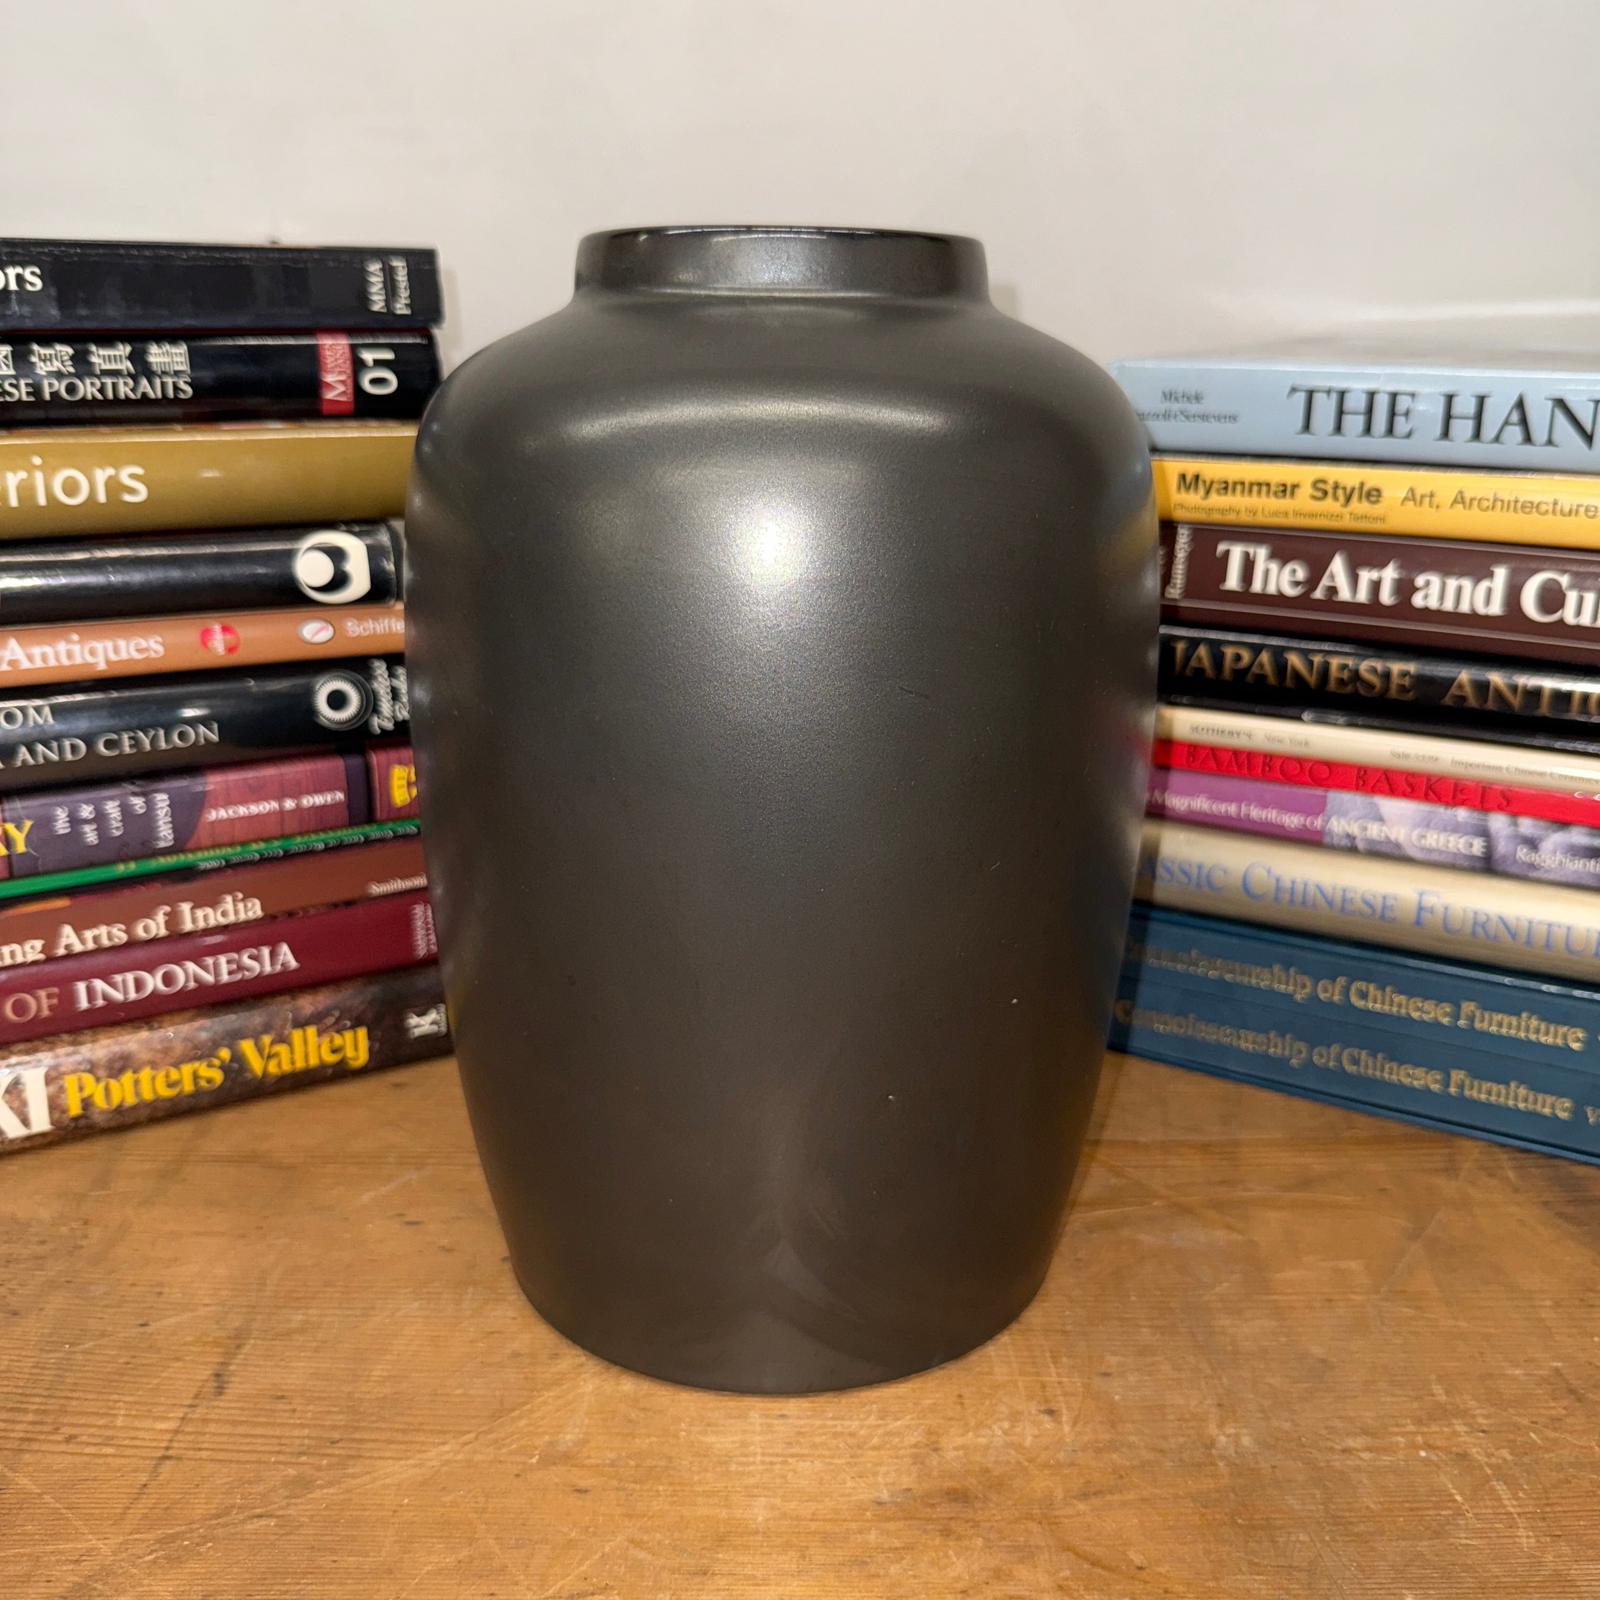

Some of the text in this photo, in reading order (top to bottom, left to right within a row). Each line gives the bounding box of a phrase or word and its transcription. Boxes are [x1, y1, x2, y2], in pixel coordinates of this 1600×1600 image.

[0, 265, 43, 292] rs
[363, 258, 387, 312] MMA
[388, 255, 411, 315] Prestel
[0, 374, 194, 402] SE PORTRAITS
[357, 347, 398, 395] 01
[1286, 385, 1600, 451] THE HAN
[1172, 502, 1241, 519] Photography
[1245, 507, 1258, 519] by
[1176, 473, 1599, 520] Myanmar Style Art, Architecture
[1216, 540, 1310, 598] The
[1310, 550, 1404, 607] Art
[1411, 564, 1510, 617] and
[0, 632, 165, 671] Antiques
[1171, 638, 1418, 701] JAPANESE
[0, 706, 55, 730] OM
[1289, 735, 1311, 747] York
[13, 720, 220, 767] AND CEYLON
[1184, 743, 1510, 812] BAMBOO BASKETS
[53, 806, 71, 835] the
[78, 803, 99, 846] art &
[103, 800, 124, 837] craft
[128, 796, 147, 815] of
[152, 793, 174, 848] tansu
[206, 790, 345, 821] JACKSON & OWEN
[1151, 789, 1240, 818] Magnificent
[1241, 801, 1304, 832] Heritage
[1306, 813, 1324, 831] of
[1326, 815, 1406, 846] ANCIENT
[1411, 826, 1488, 858] GREECE
[0, 819, 34, 857] Y
[1240, 861, 1397, 922] CHINESE
[54, 923, 128, 956] Arts
[131, 905, 171, 941] of
[176, 891, 264, 933] India
[4, 941, 300, 1023] OF INDONESIA
[1316, 975, 1348, 1004] of
[1349, 979, 1456, 1027] Chinese
[1456, 1000, 1588, 1051] Furniture
[63, 1046, 232, 1119] Potters'
[239, 1024, 370, 1079] Valley
[1311, 1043, 1343, 1071] of
[1341, 1047, 1446, 1095] Chinese
[1447, 1067, 1577, 1121] Furniture
